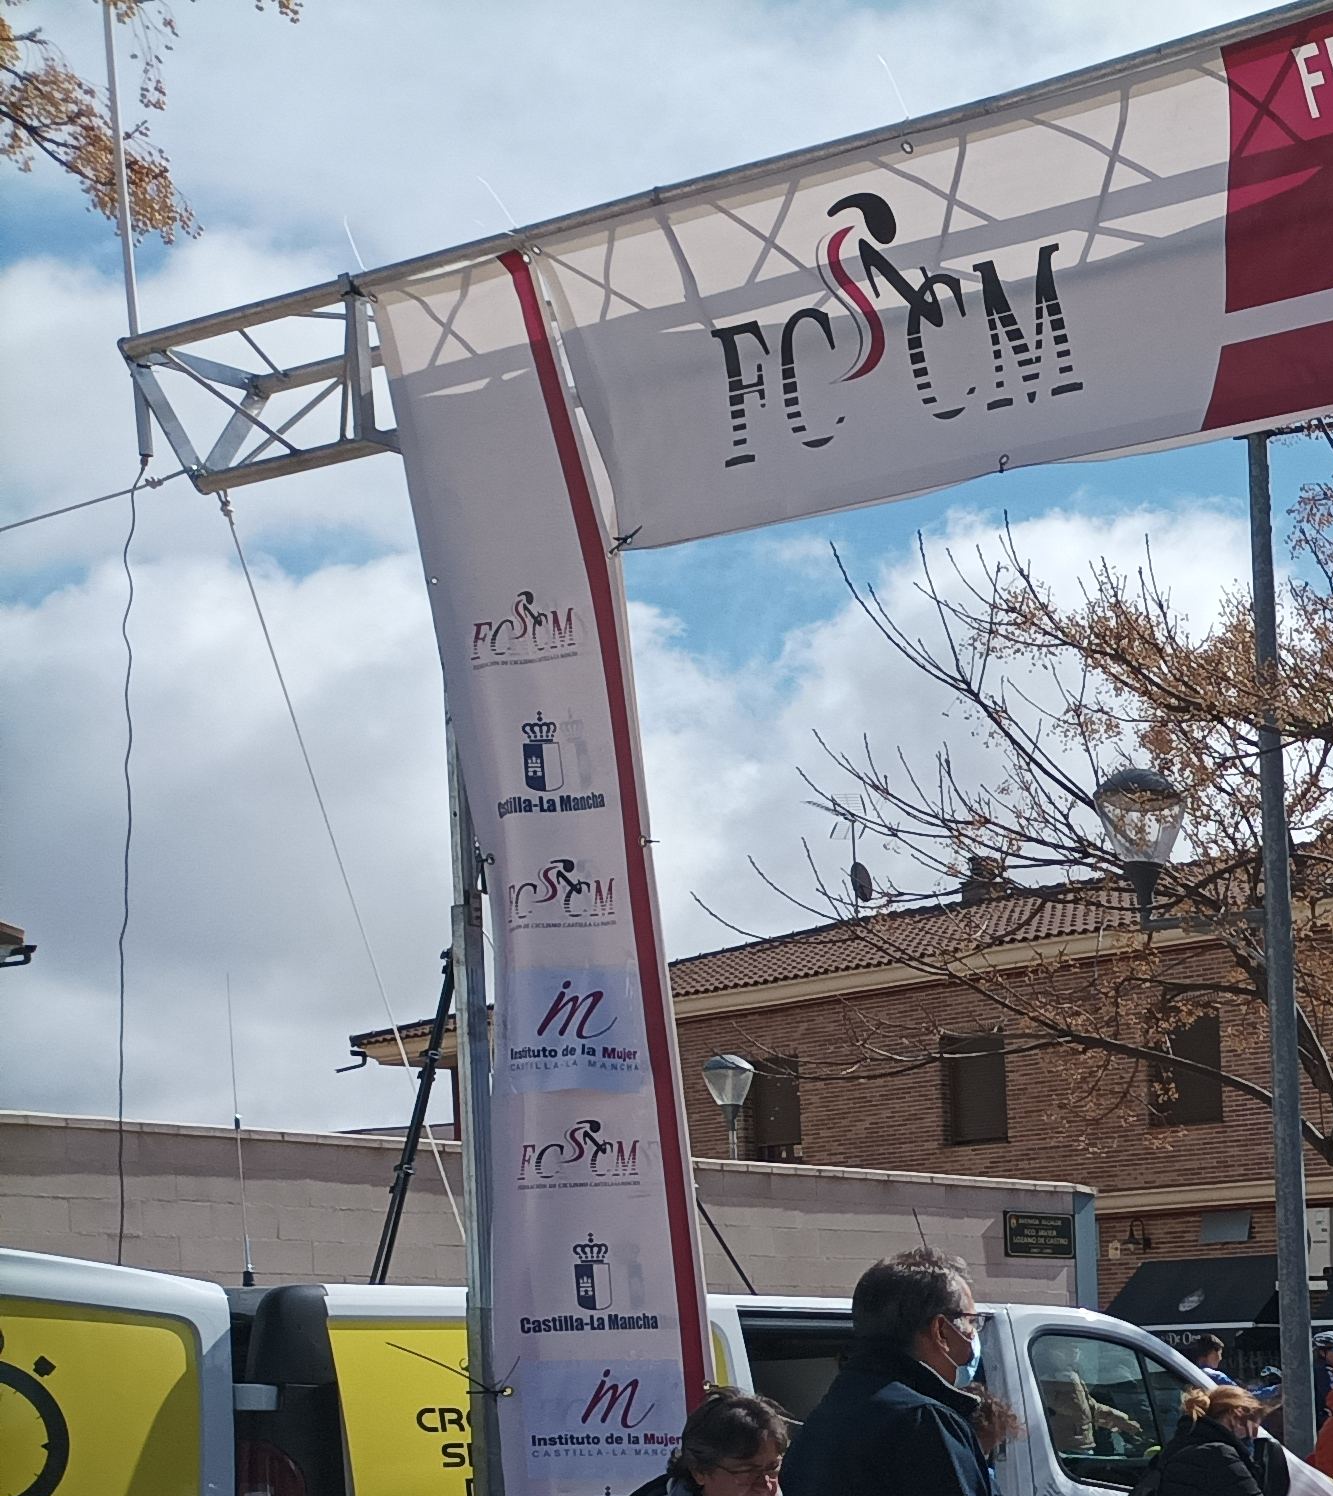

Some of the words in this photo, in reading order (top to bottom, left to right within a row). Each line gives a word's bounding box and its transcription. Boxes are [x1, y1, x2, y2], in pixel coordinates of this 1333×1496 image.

[559, 791, 606, 812] Mancha
[510, 1046, 558, 1060] Instituto
[561, 1045, 576, 1057] de
[581, 1043, 596, 1057] la
[602, 1046, 638, 1061] Mujer
[587, 1059, 640, 1071] MANCHA
[520, 1312, 605, 1334] Castilla-La
[608, 1312, 658, 1331] Mancha
[531, 1434, 600, 1447] Instituto
[605, 1433, 624, 1445] de
[628, 1433, 640, 1445] la
[643, 1433, 682, 1449] Mujer
[531, 1447, 627, 1458] CASTILLA-LA
